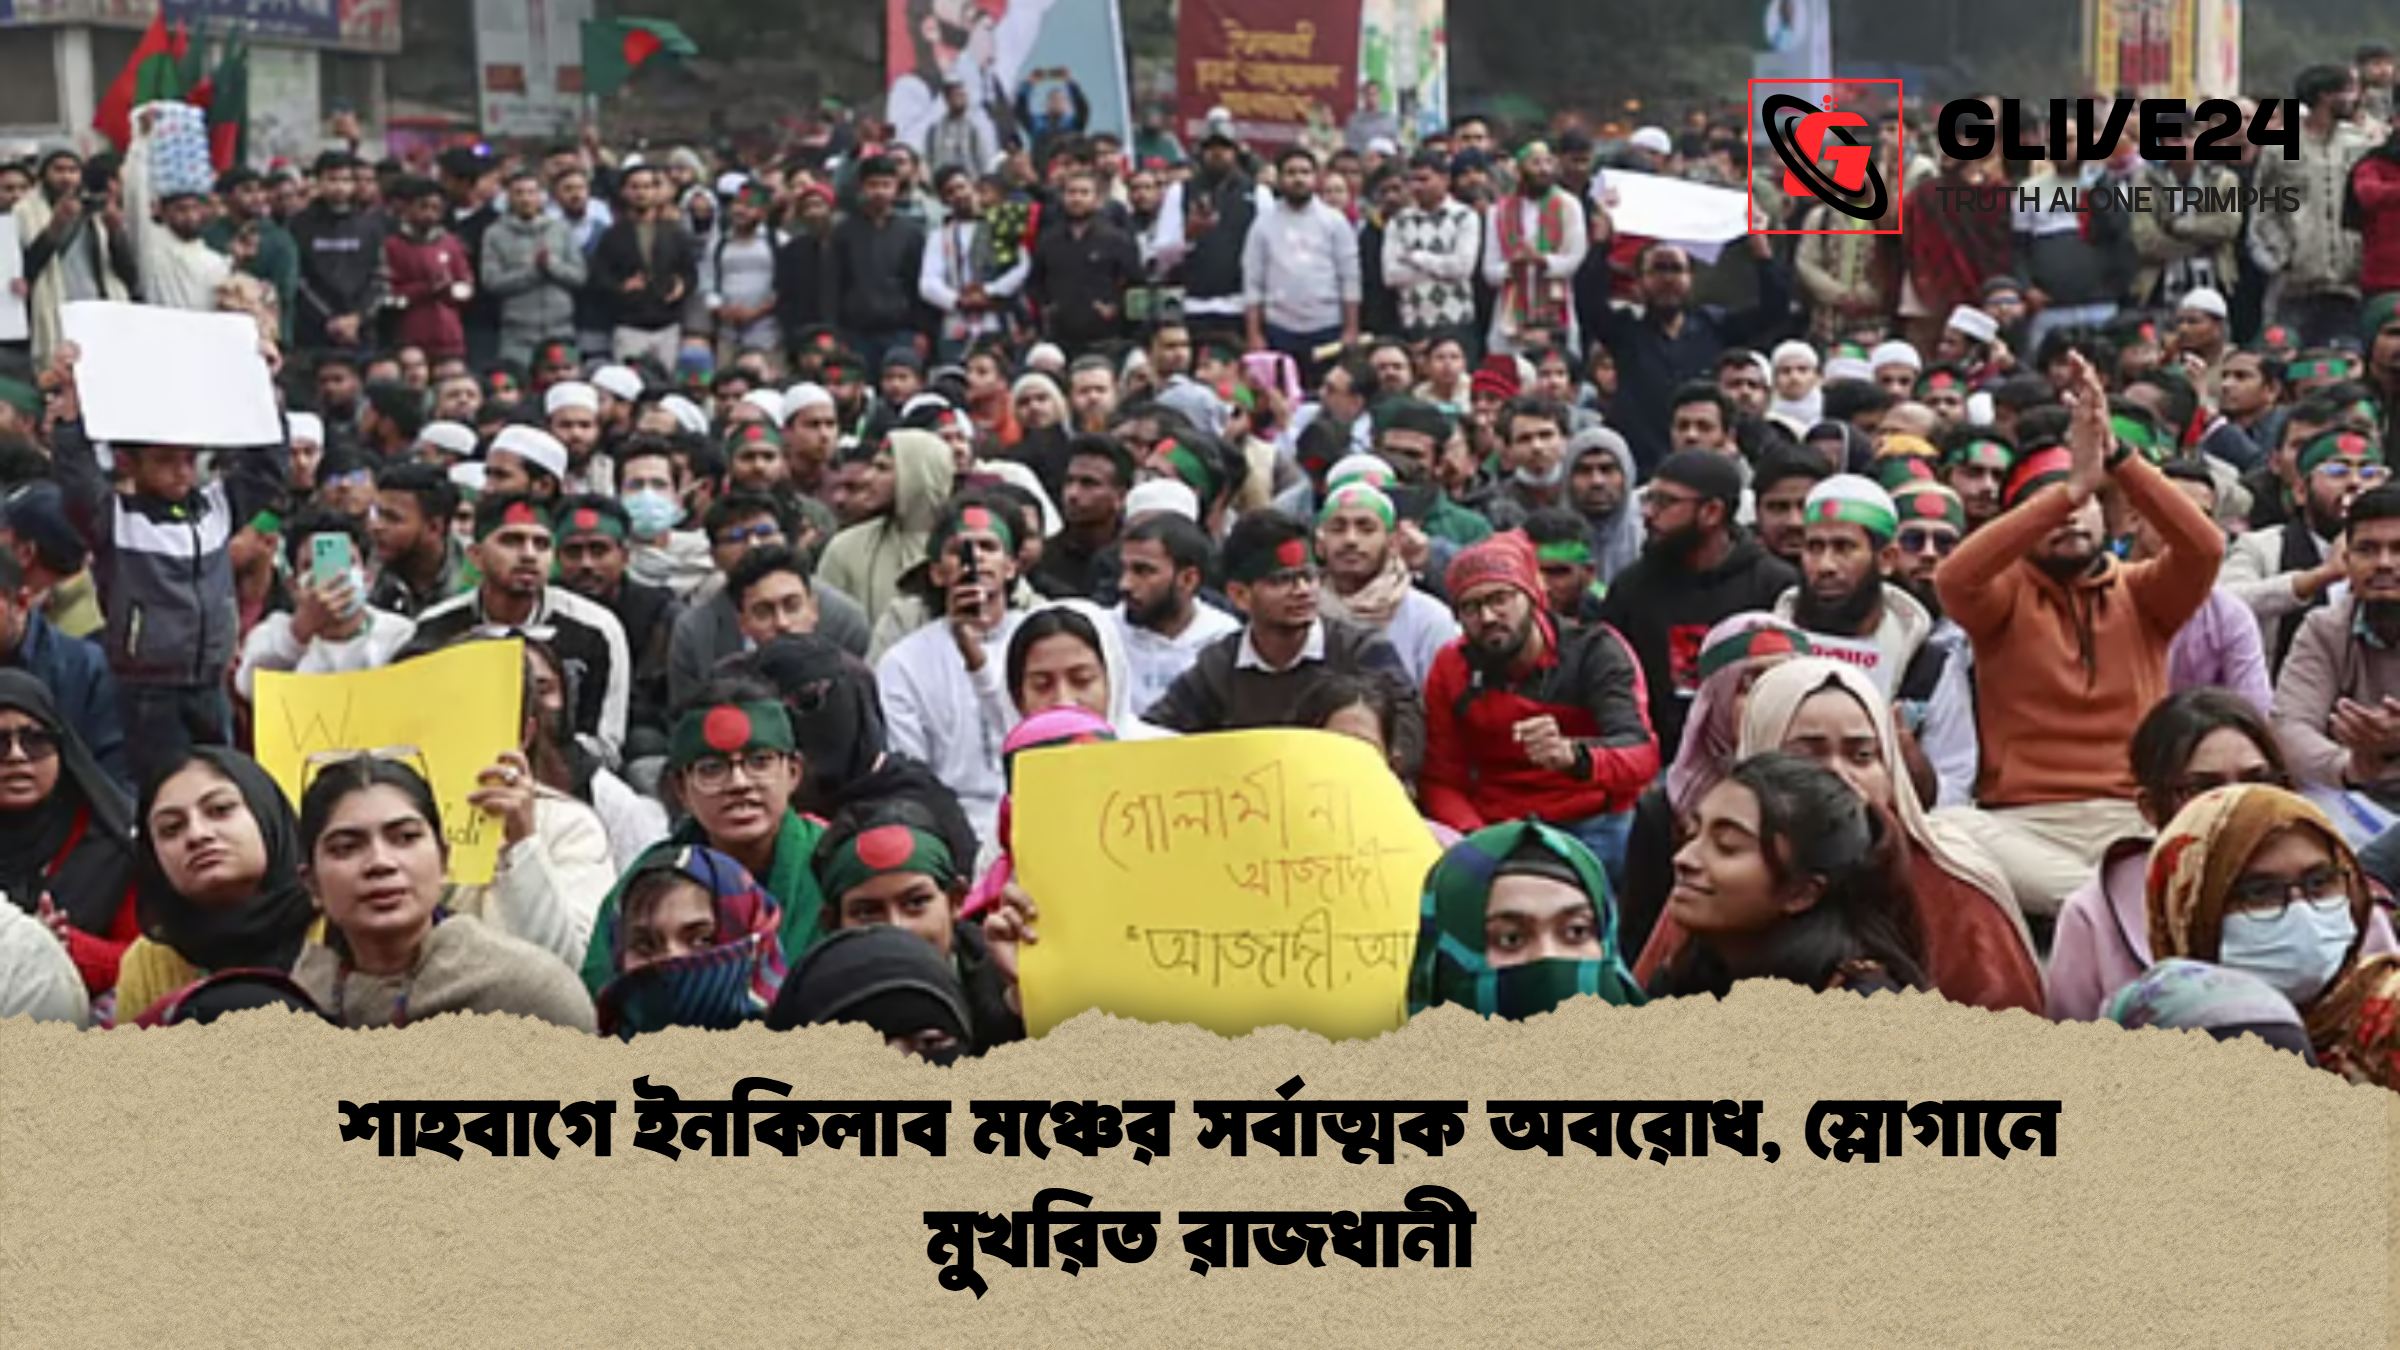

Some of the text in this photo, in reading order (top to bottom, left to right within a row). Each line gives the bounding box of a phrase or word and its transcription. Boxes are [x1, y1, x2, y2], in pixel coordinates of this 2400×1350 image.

[1100, 759, 1355, 872] গোলামী না
[1224, 836, 1408, 911] আজাদী
